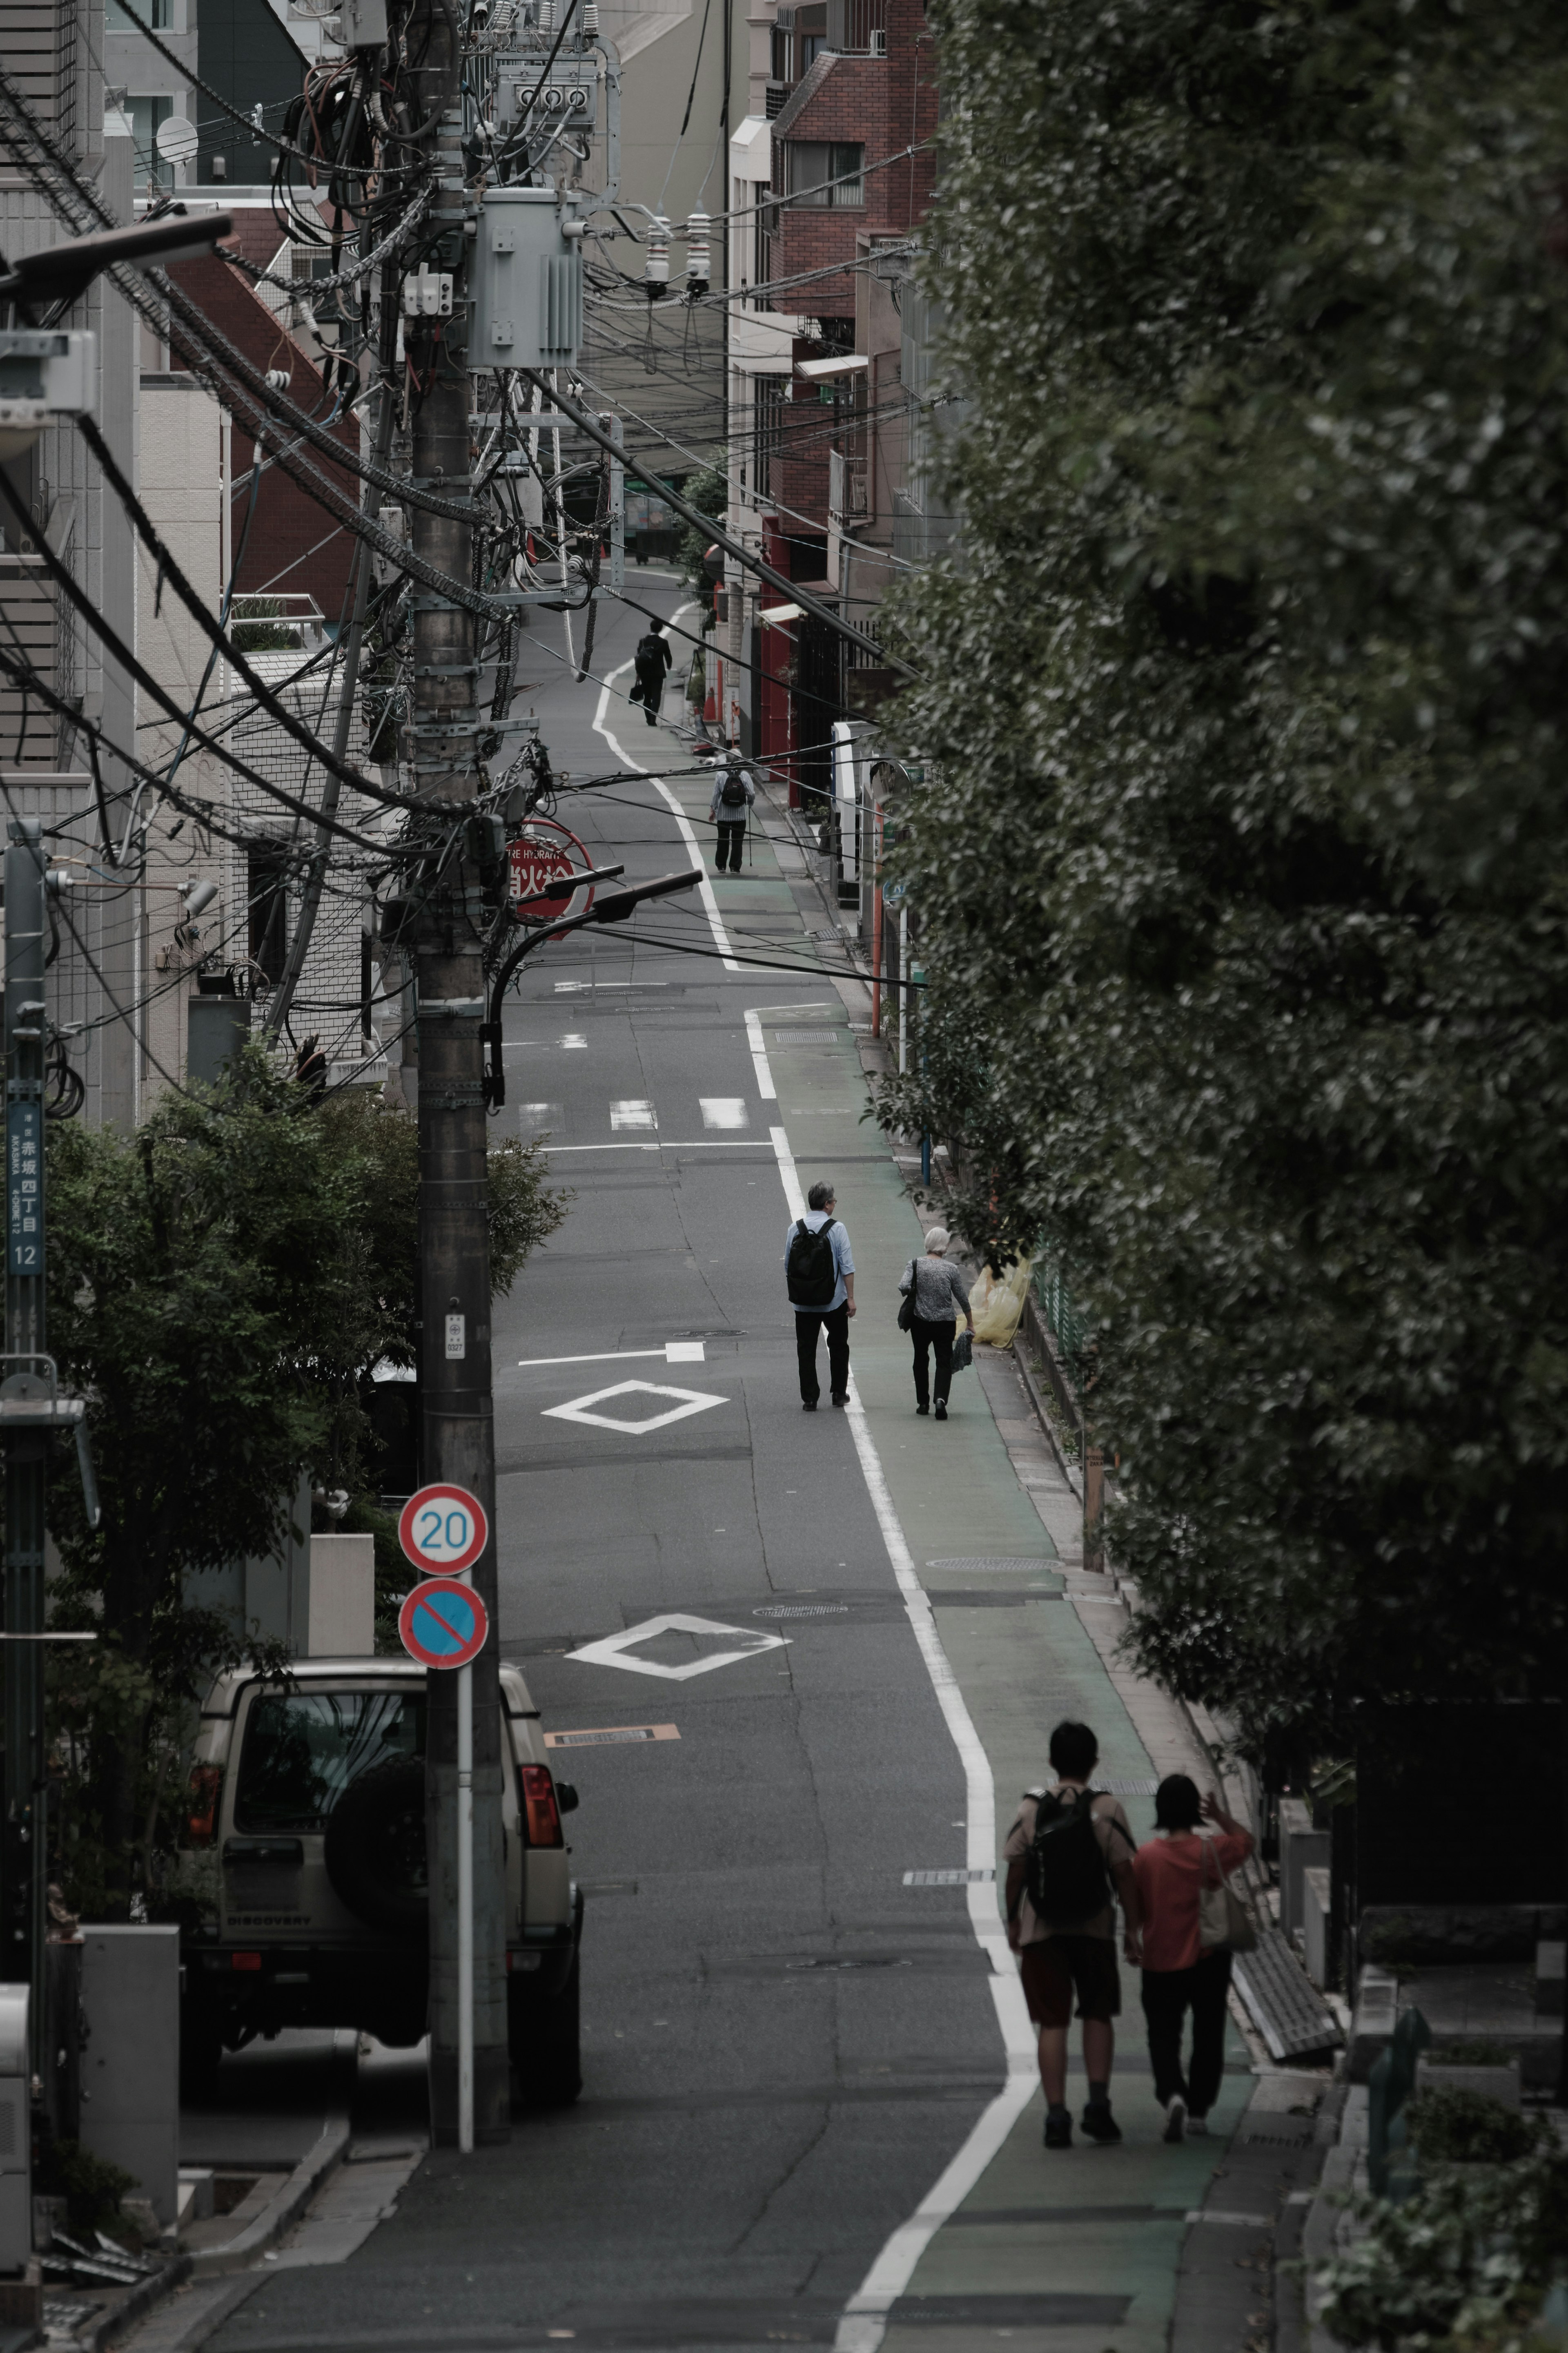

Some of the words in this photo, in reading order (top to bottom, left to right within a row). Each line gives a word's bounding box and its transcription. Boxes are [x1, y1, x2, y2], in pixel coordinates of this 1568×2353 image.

[24, 1114, 33, 1137] 港区
[11, 1135, 20, 1175] AKASAKA
[21, 1142, 37, 1232] 赤坂四丁目
[12, 1189, 20, 1221] 4-CHOME
[15, 1246, 36, 1264] 12
[421, 1512, 467, 1549] 20
[227, 1917, 312, 1926] DISCOVERY
